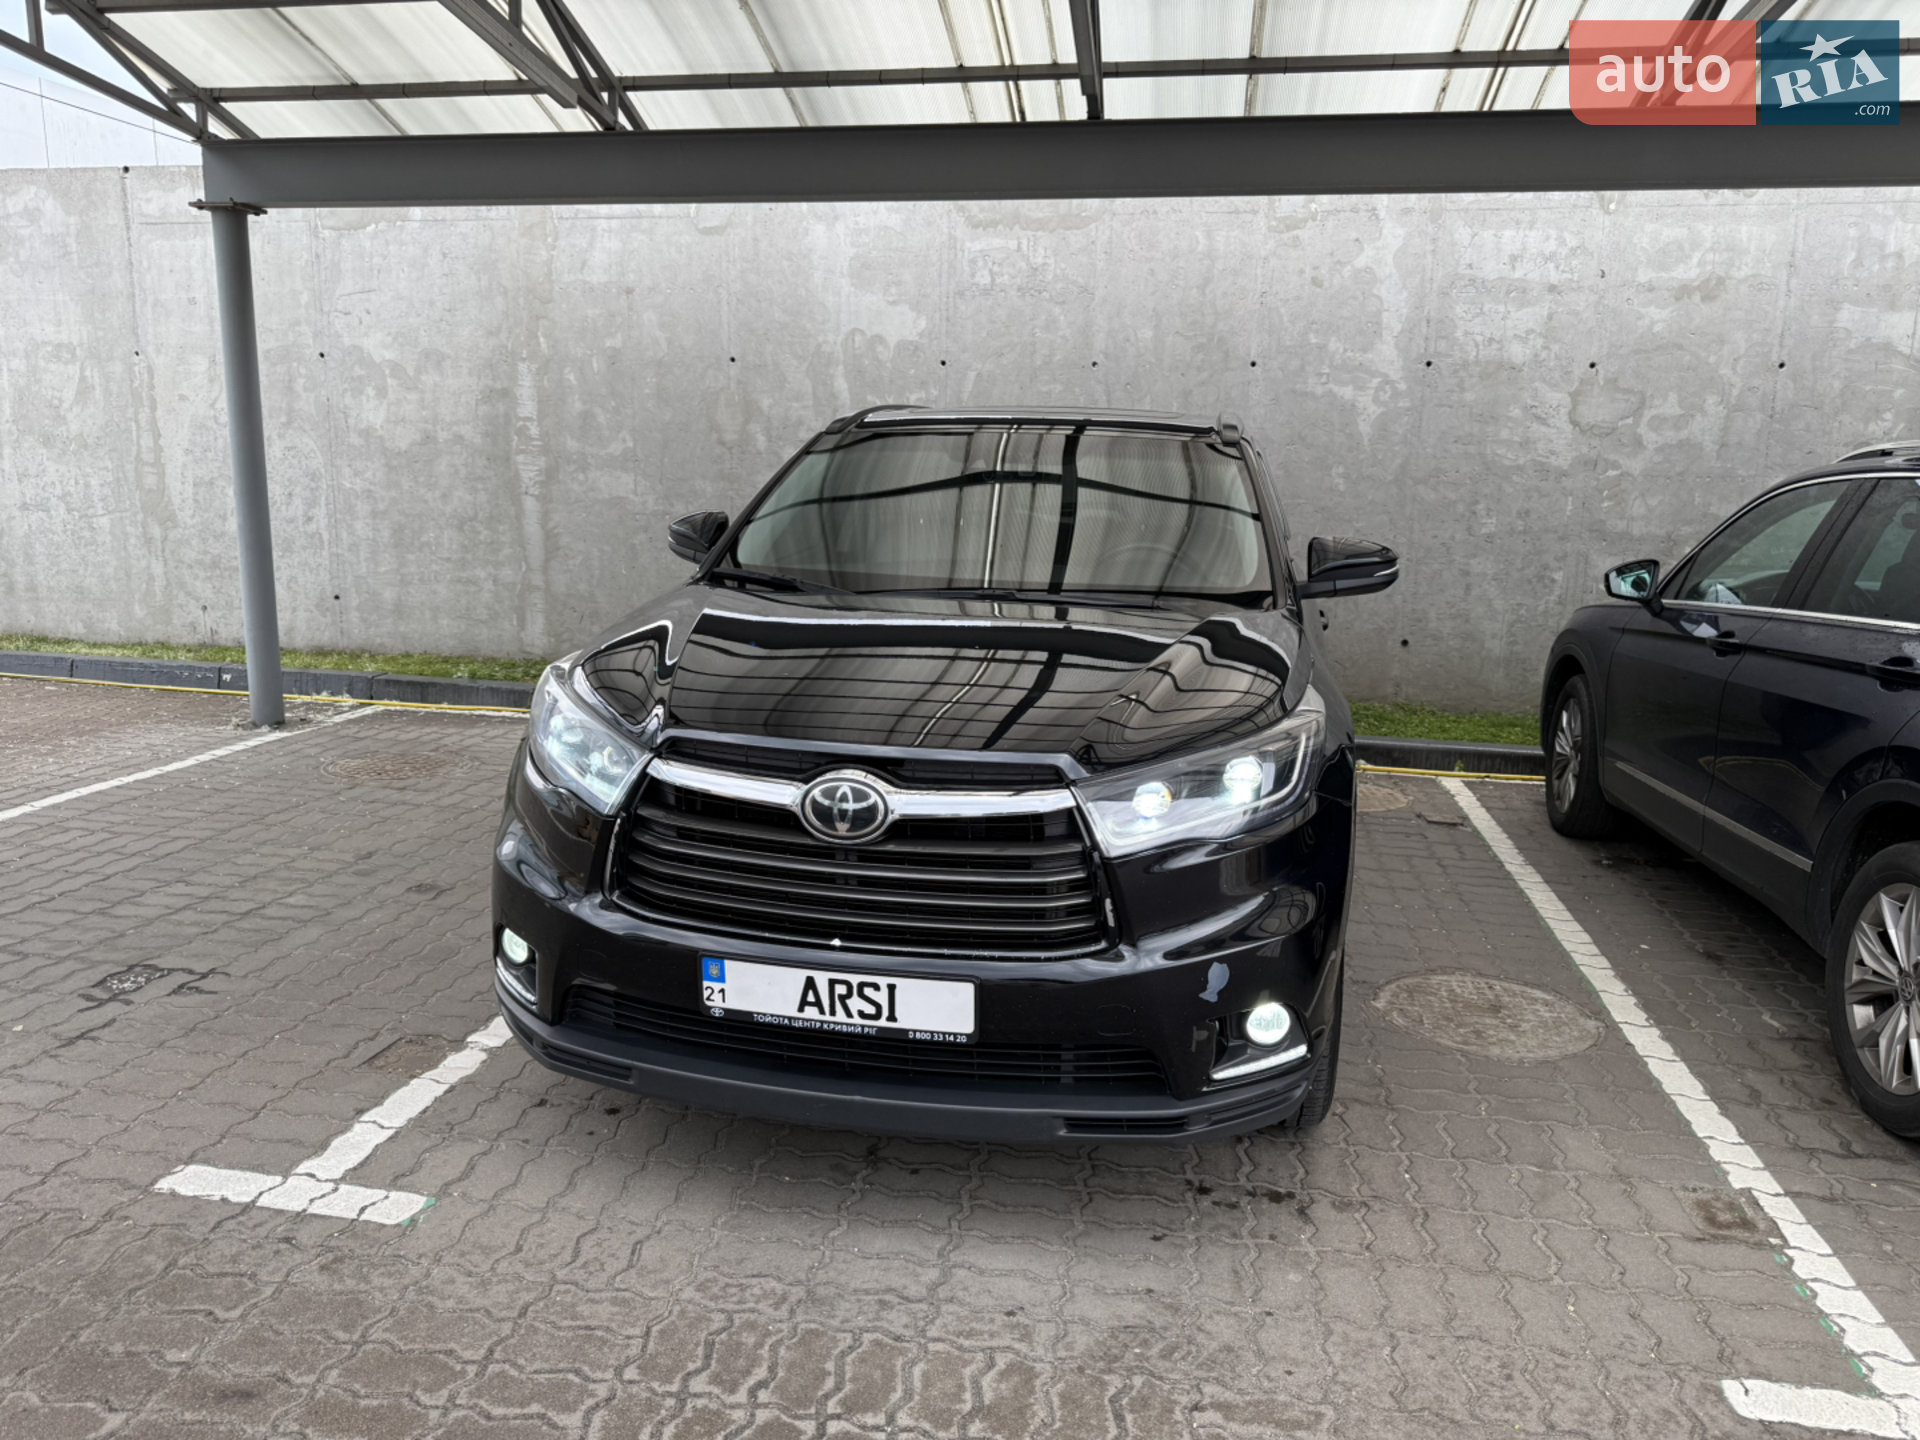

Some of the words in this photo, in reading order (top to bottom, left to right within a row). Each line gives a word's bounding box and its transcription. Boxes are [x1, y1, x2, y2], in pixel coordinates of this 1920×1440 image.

[704, 985, 726, 1004] 21
[797, 975, 898, 1023] ARSI
[753, 1013, 790, 1025] ТОЙОТА
[792, 1019, 821, 1029] ЦЕНТР
[823, 1023, 862, 1033] КРИВИЙ
[863, 1027, 878, 1035] РІГ
[908, 1031, 914, 1039] 0
[915, 1032, 932, 1040] 800
[933, 1033, 944, 1041] 33
[945, 1034, 955, 1042] 14
[956, 1035, 967, 1043] 20
